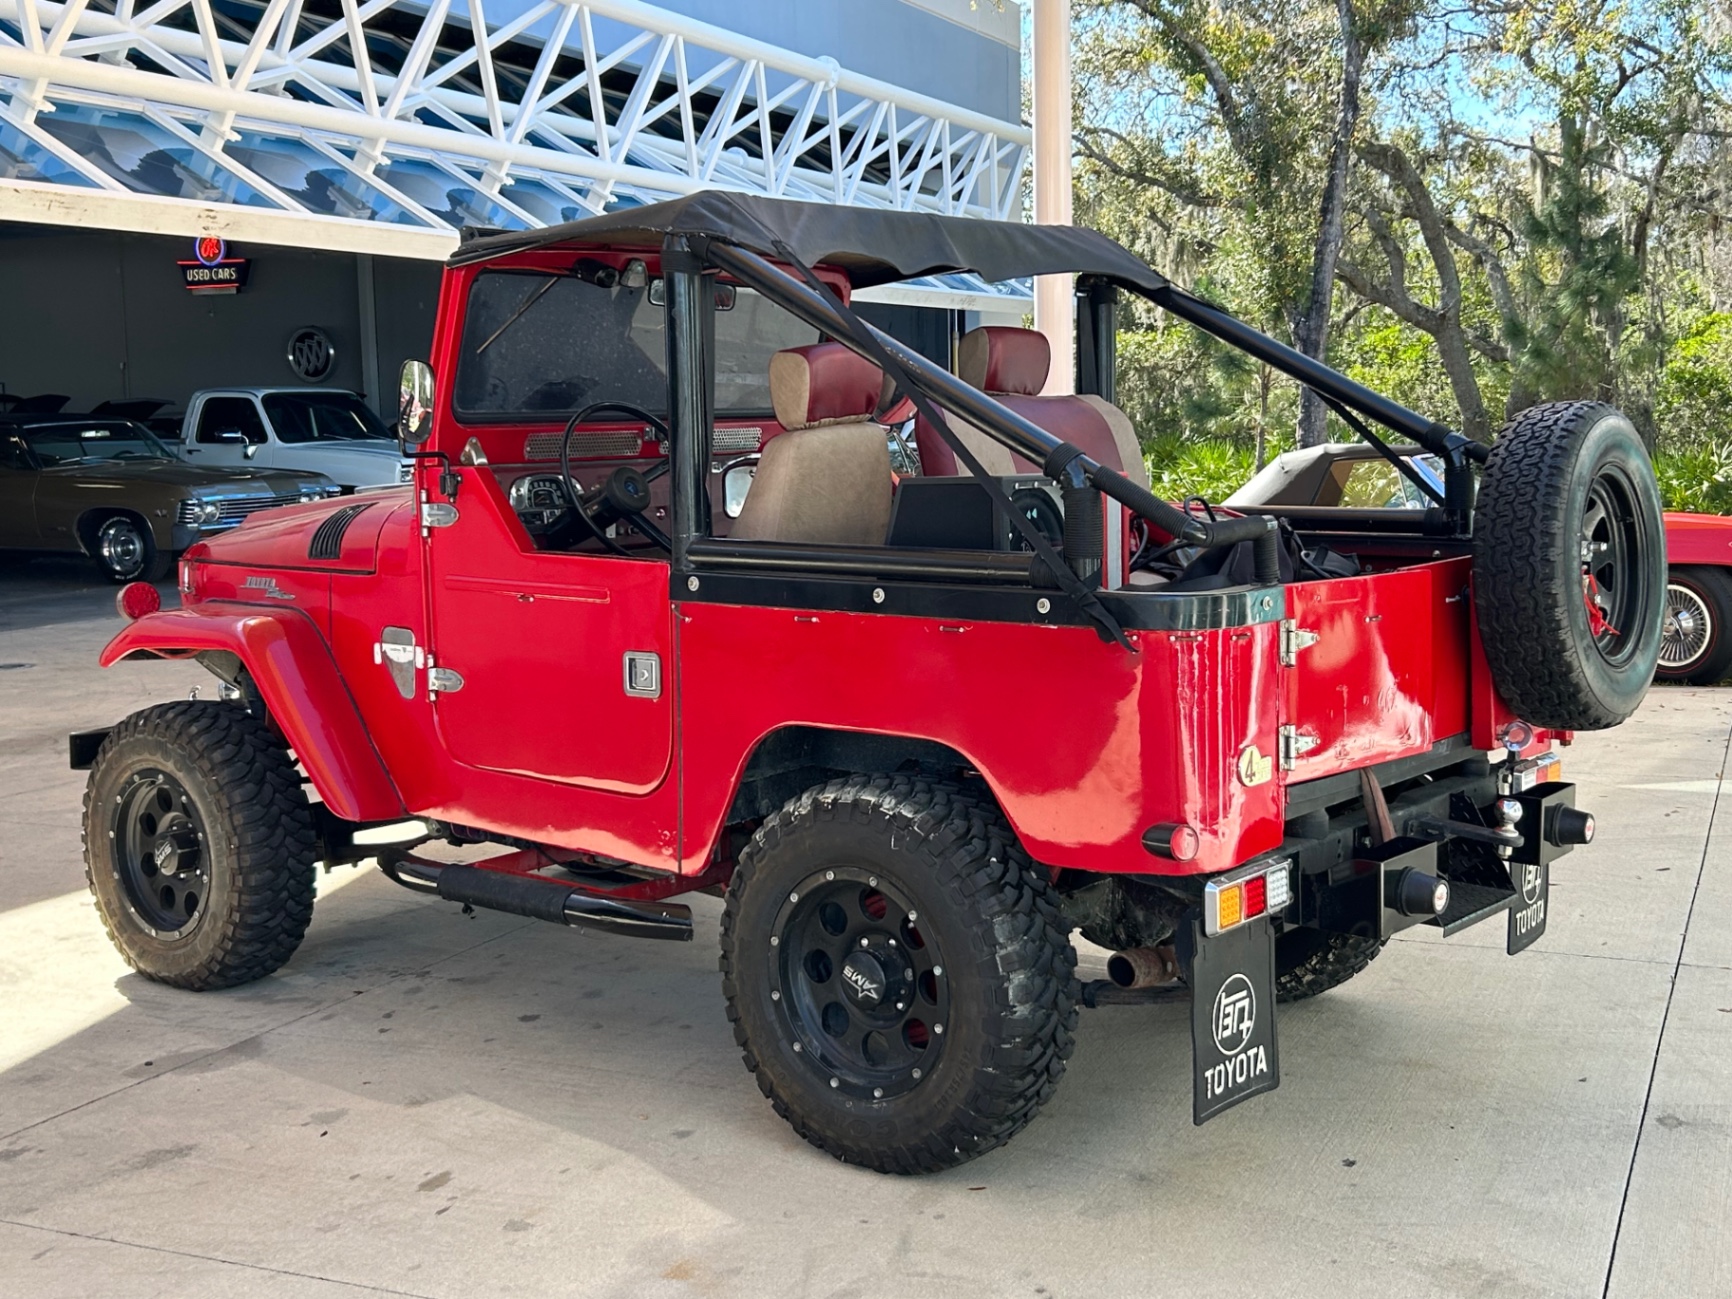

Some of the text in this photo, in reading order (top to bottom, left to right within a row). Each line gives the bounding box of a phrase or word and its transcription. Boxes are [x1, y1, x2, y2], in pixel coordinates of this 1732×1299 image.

[186, 267, 237, 281] USED CARS
[1516, 898, 1544, 936] TOYOTA
[842, 965, 879, 990] AMS
[1204, 1044, 1268, 1099] TOYOTA
